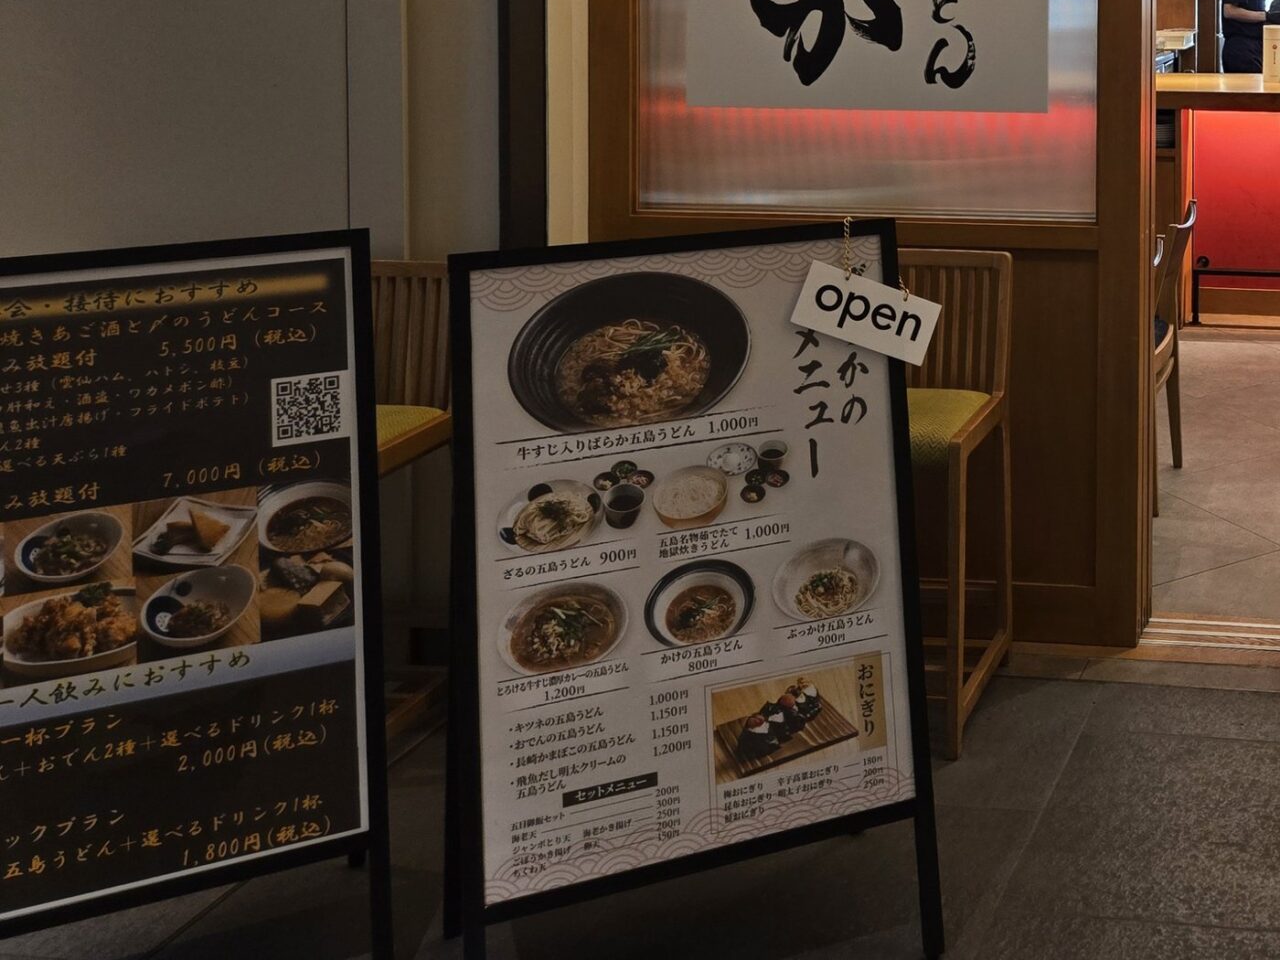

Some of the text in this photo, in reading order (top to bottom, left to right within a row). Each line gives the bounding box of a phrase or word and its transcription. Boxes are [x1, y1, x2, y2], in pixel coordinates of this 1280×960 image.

[0, 281, 259, 318] 会・接待におすすめ
[815, 283, 922, 341] open
[2, 350, 98, 373] み放題付
[793, 328, 834, 478] メニュー
[516, 415, 759, 460] 牛すじ入りばらか五島うどん 1,000円
[4, 481, 100, 510] み放題付
[744, 523, 790, 541] 1,000円
[502, 549, 637, 580] ざるの五島うどん 900円
[787, 614, 874, 640] ぶっかけ五島うどん
[817, 633, 845, 645] 900円
[660, 639, 743, 665] かけの五島うどん
[688, 658, 717, 672] 800円
[544, 685, 585, 702] 1,200円
[649, 690, 689, 706] 1,000円
[857, 663, 876, 737] おにぎり
[650, 705, 688, 722] 1,150円
[652, 723, 689, 740] 1,150円
[653, 740, 691, 757] 1,200円
[575, 777, 648, 801] セットメニュー
